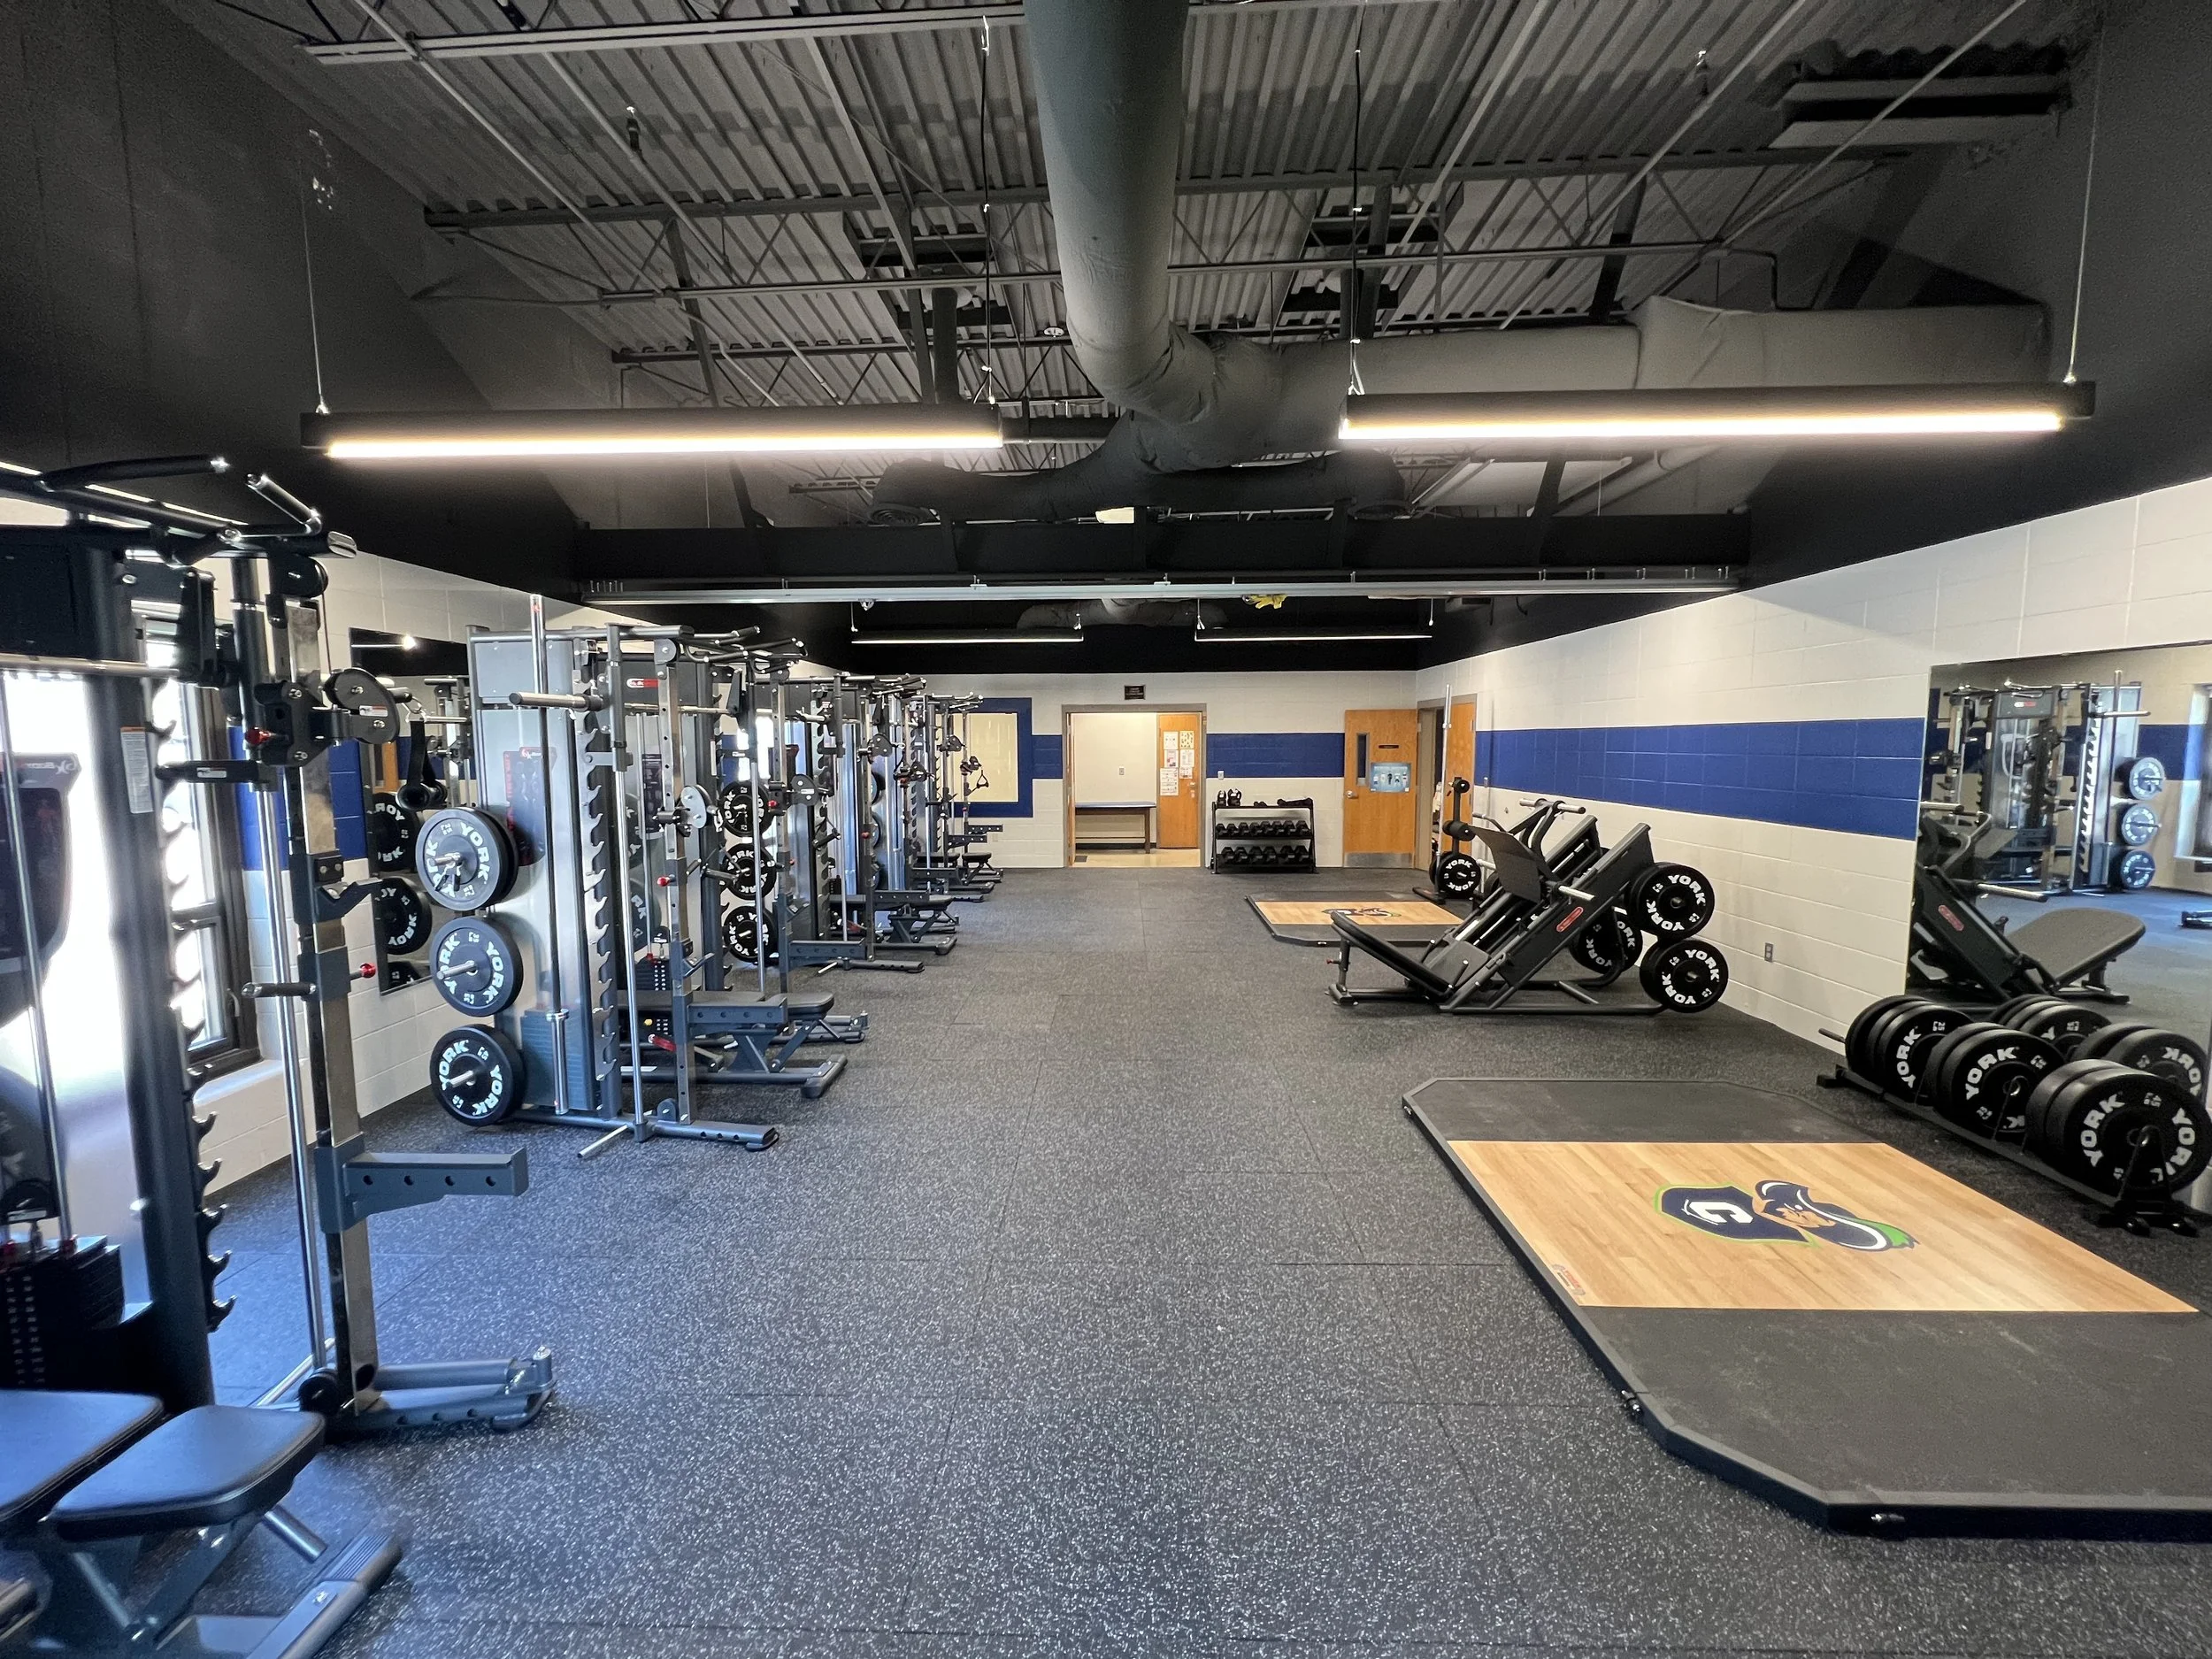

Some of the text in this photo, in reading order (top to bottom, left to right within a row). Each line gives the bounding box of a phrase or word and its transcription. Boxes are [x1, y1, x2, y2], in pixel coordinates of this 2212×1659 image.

[460, 822, 490, 883] YORK
[1446, 859, 1473, 869] YORK
[1448, 881, 1474, 891] YORK
[1668, 875, 1706, 905] YORK
[1617, 920, 1635, 948] ORK
[1647, 901, 1685, 931] YORK
[482, 941, 504, 1002] YORK
[1685, 949, 1720, 980] YORK
[1662, 973, 1696, 1004] YORK
[439, 1040, 469, 1091] YORK
[1896, 1028, 1921, 1088] YORK
[1965, 1047, 2017, 1100] YORK
[472, 1064, 503, 1115] YORK
[2081, 1094, 2126, 1167] YORK
